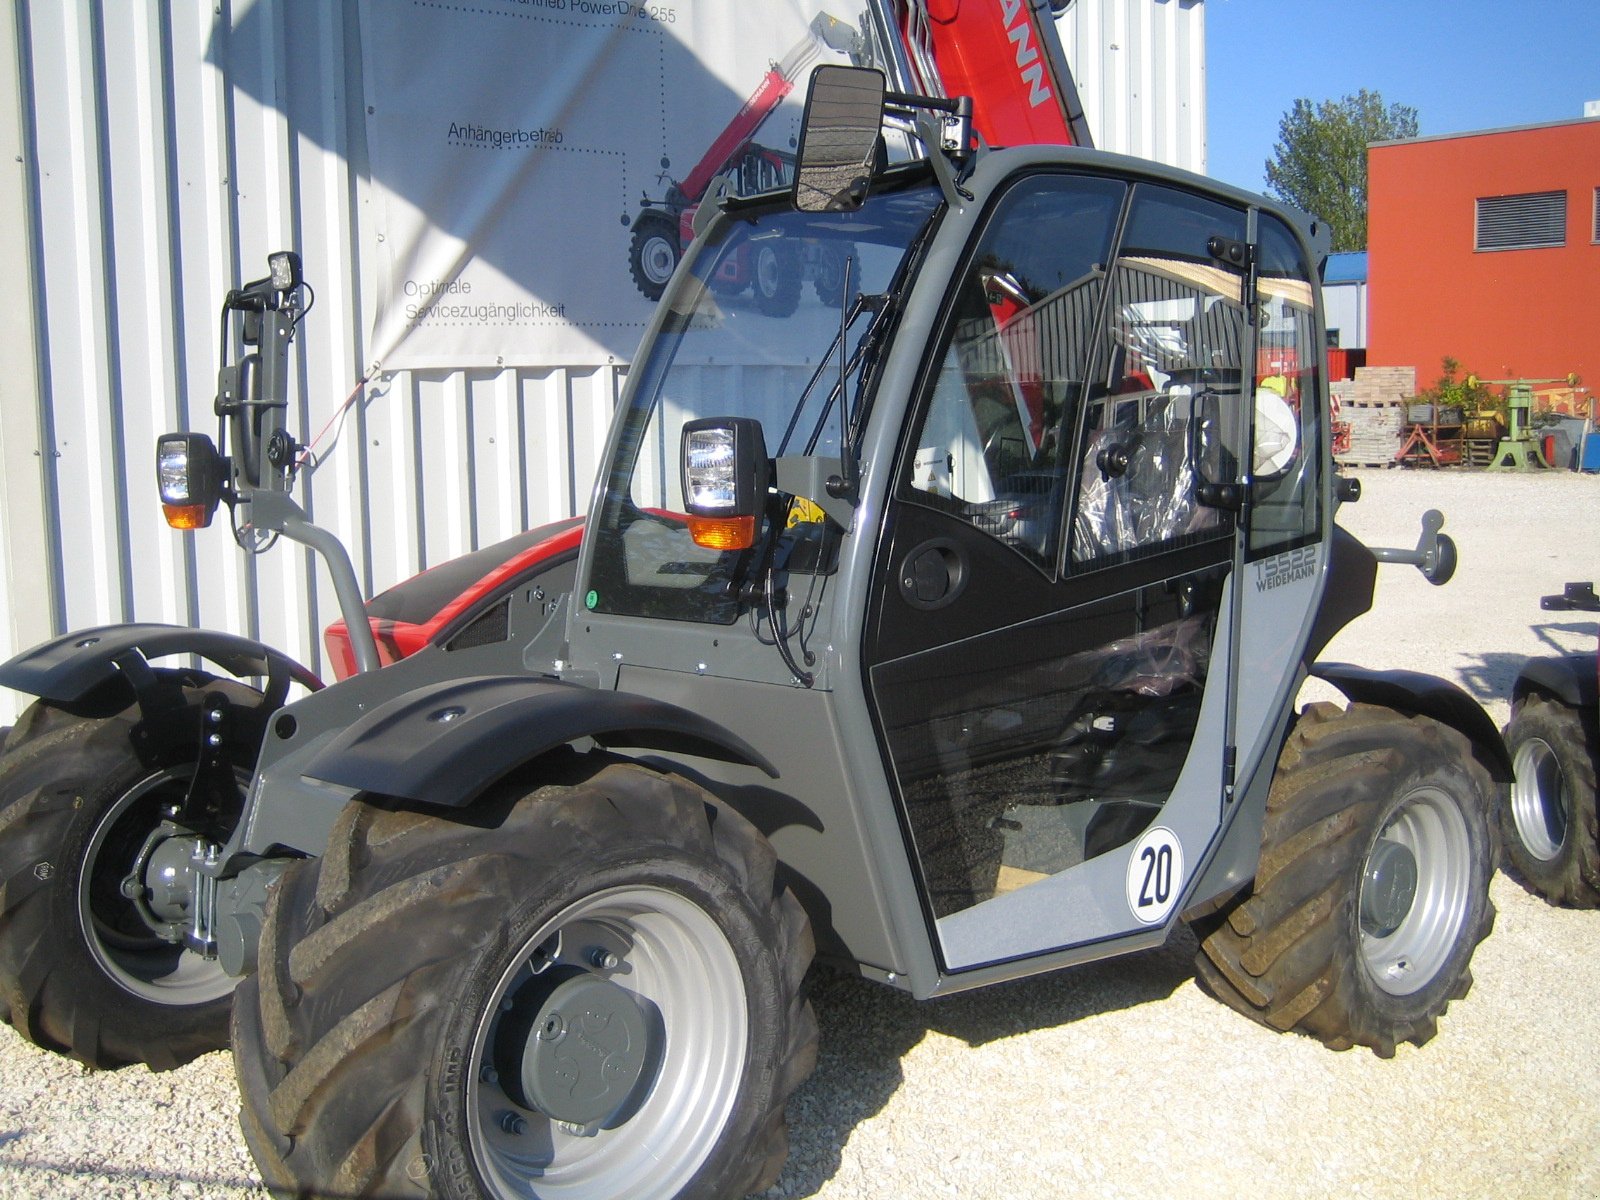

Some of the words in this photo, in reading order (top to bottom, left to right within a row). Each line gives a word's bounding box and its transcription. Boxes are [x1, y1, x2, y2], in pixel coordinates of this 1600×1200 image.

[650, 6, 677, 24] 255
[1001, 0, 1051, 108] ANN
[404, 278, 472, 299] Optimale
[405, 302, 566, 322] Servicezugänglichkeit
[1253, 546, 1316, 579] T5522
[1256, 565, 1315, 592] WEIDEMANN
[1138, 843, 1173, 908] 20
